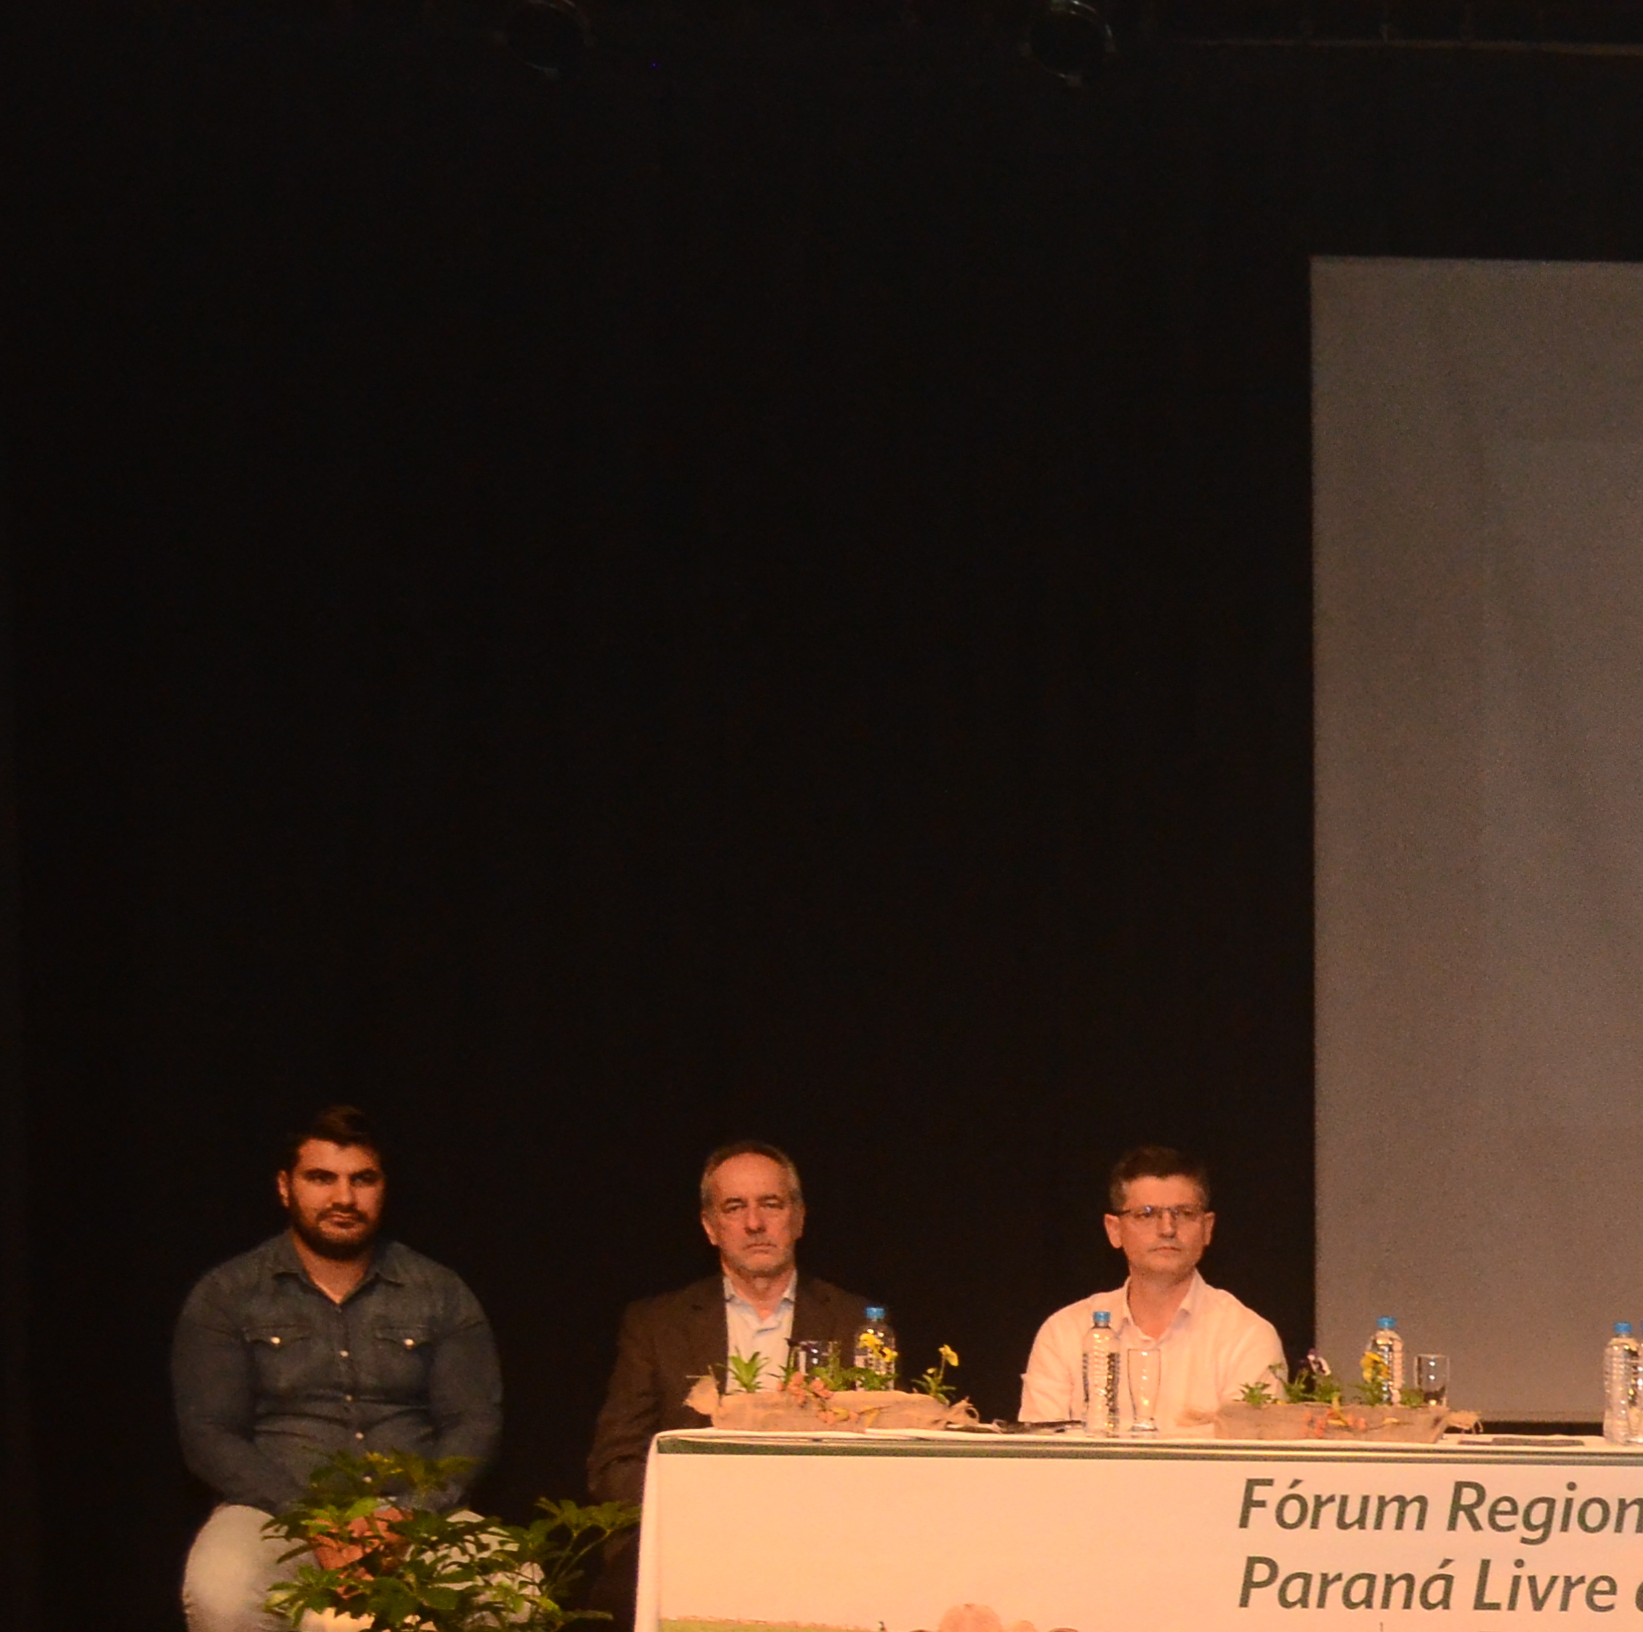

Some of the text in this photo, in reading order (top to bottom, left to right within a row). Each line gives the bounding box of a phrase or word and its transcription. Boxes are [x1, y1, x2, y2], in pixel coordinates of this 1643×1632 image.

[1238, 1478, 1428, 1531] Fórum
[1238, 1555, 1455, 1609] Paraná
[1472, 1558, 1618, 1612] Livre
